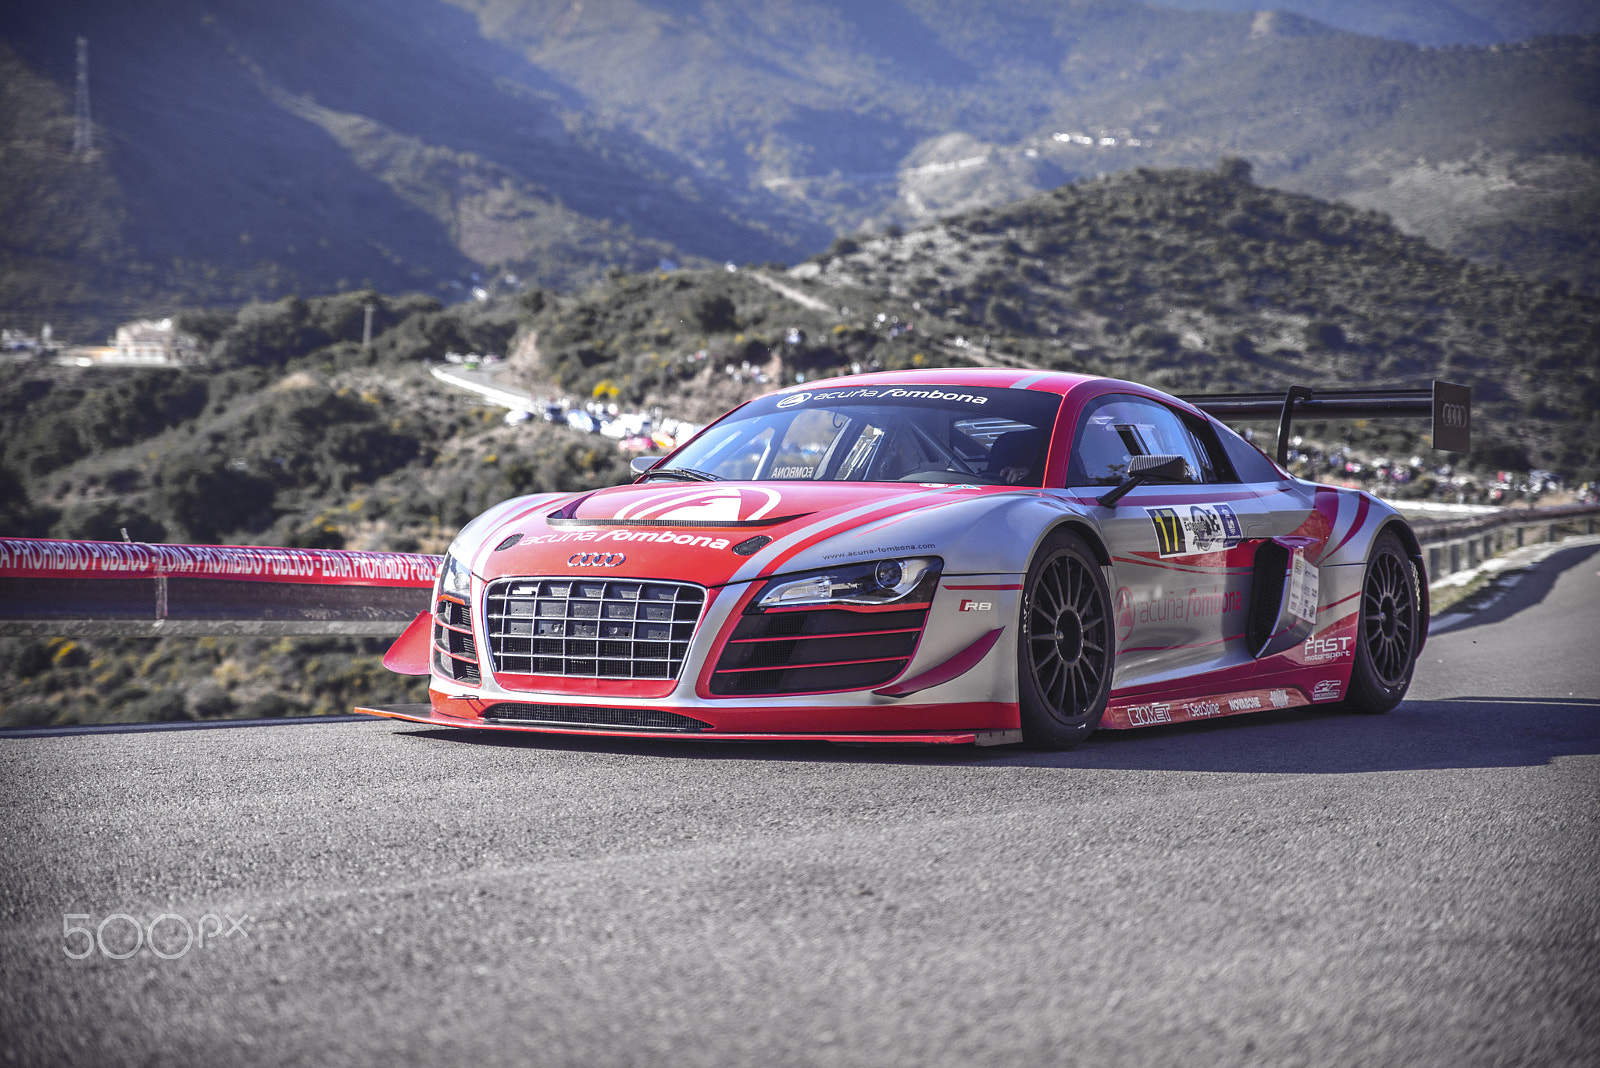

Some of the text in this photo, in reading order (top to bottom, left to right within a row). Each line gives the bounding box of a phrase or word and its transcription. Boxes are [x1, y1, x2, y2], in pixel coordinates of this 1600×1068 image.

[877, 388, 989, 404] fombona
[594, 529, 731, 550] fombona
[1154, 509, 1179, 552] 17
[5, 540, 90, 571] PROHIBIDO
[84, 543, 149, 572] PUBLICO
[157, 546, 194, 573] ZONA
[188, 547, 263, 575] PROHIBIDO
[256, 549, 315, 577] PUBLICO
[315, 551, 353, 578] ZONA
[346, 553, 409, 580] PROHIBIDO
[822, 543, 936, 560] www.acuna-fombona.com
[961, 600, 992, 611] R8
[1139, 587, 1242, 623] acuña fombona
[1305, 636, 1352, 655] FAST
[1304, 650, 1351, 661] motorsport
